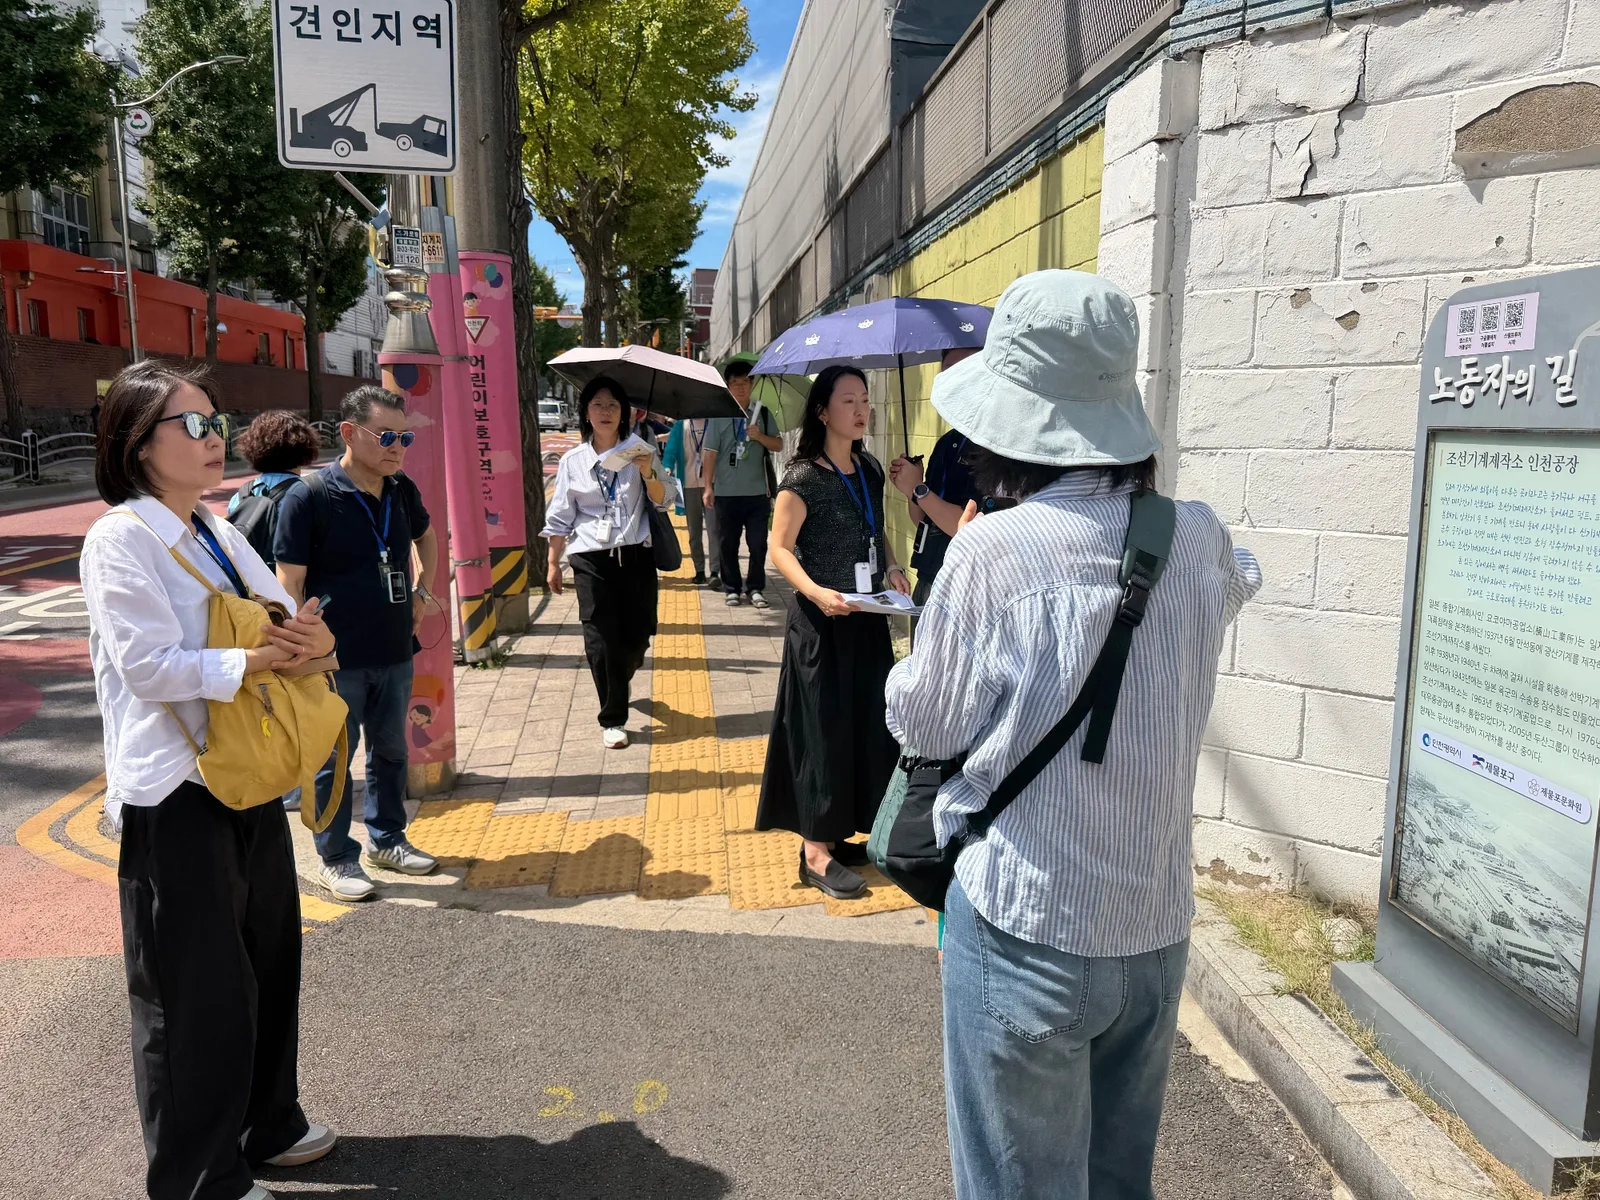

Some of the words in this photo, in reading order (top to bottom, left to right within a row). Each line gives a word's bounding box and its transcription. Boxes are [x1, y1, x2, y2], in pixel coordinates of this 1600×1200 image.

[289, 5, 441, 49] 견인지역
[406, 255, 420, 264] 120
[1429, 355, 1536, 407] 노동자의
[1545, 350, 1578, 404] 길
[1446, 450, 1523, 470] 조선기계제작소
[1528, 453, 1580, 475] 인천공장
[1550, 490, 1575, 501] 농기구나
[1577, 493, 1596, 505] 어구를
[1540, 523, 1567, 534] 사람들이
[1568, 526, 1576, 534] 다
[1539, 570, 1565, 583] 들어가려
[1585, 561, 1592, 572] 수
[1546, 588, 1564, 601] 무기를
[1567, 592, 1591, 605] 만들려고
[1428, 598, 1439, 610] 일본
[1442, 601, 1483, 621] 종합기계회사인
[1484, 630, 1503, 643] 1937년
[1503, 635, 1515, 647] 6월
[1516, 638, 1543, 654] 만석동에
[1544, 645, 1578, 665] 광산기계를
[1424, 644, 1435, 656] 이후
[1481, 662, 1488, 673] 두
[1510, 671, 1523, 684] 걸쳐
[1524, 676, 1544, 691] 시설을
[1546, 682, 1568, 698] 확충해
[1484, 680, 1496, 693] 일본
[1498, 684, 1517, 700] 육군의
[1518, 692, 1539, 707] 수송용
[1541, 699, 1570, 717] 잠수함도
[1508, 723, 1532, 741] 2005년
[1533, 733, 1569, 755] 두산그룹이
[1557, 723, 1572, 737] 다시
[1432, 738, 1462, 759] 인천광역시
[1505, 739, 1518, 753] 생산
[1520, 745, 1542, 763] 중이다.
[1485, 761, 1515, 783] 제물포구
[1540, 787, 1582, 814] 제물포문화원
